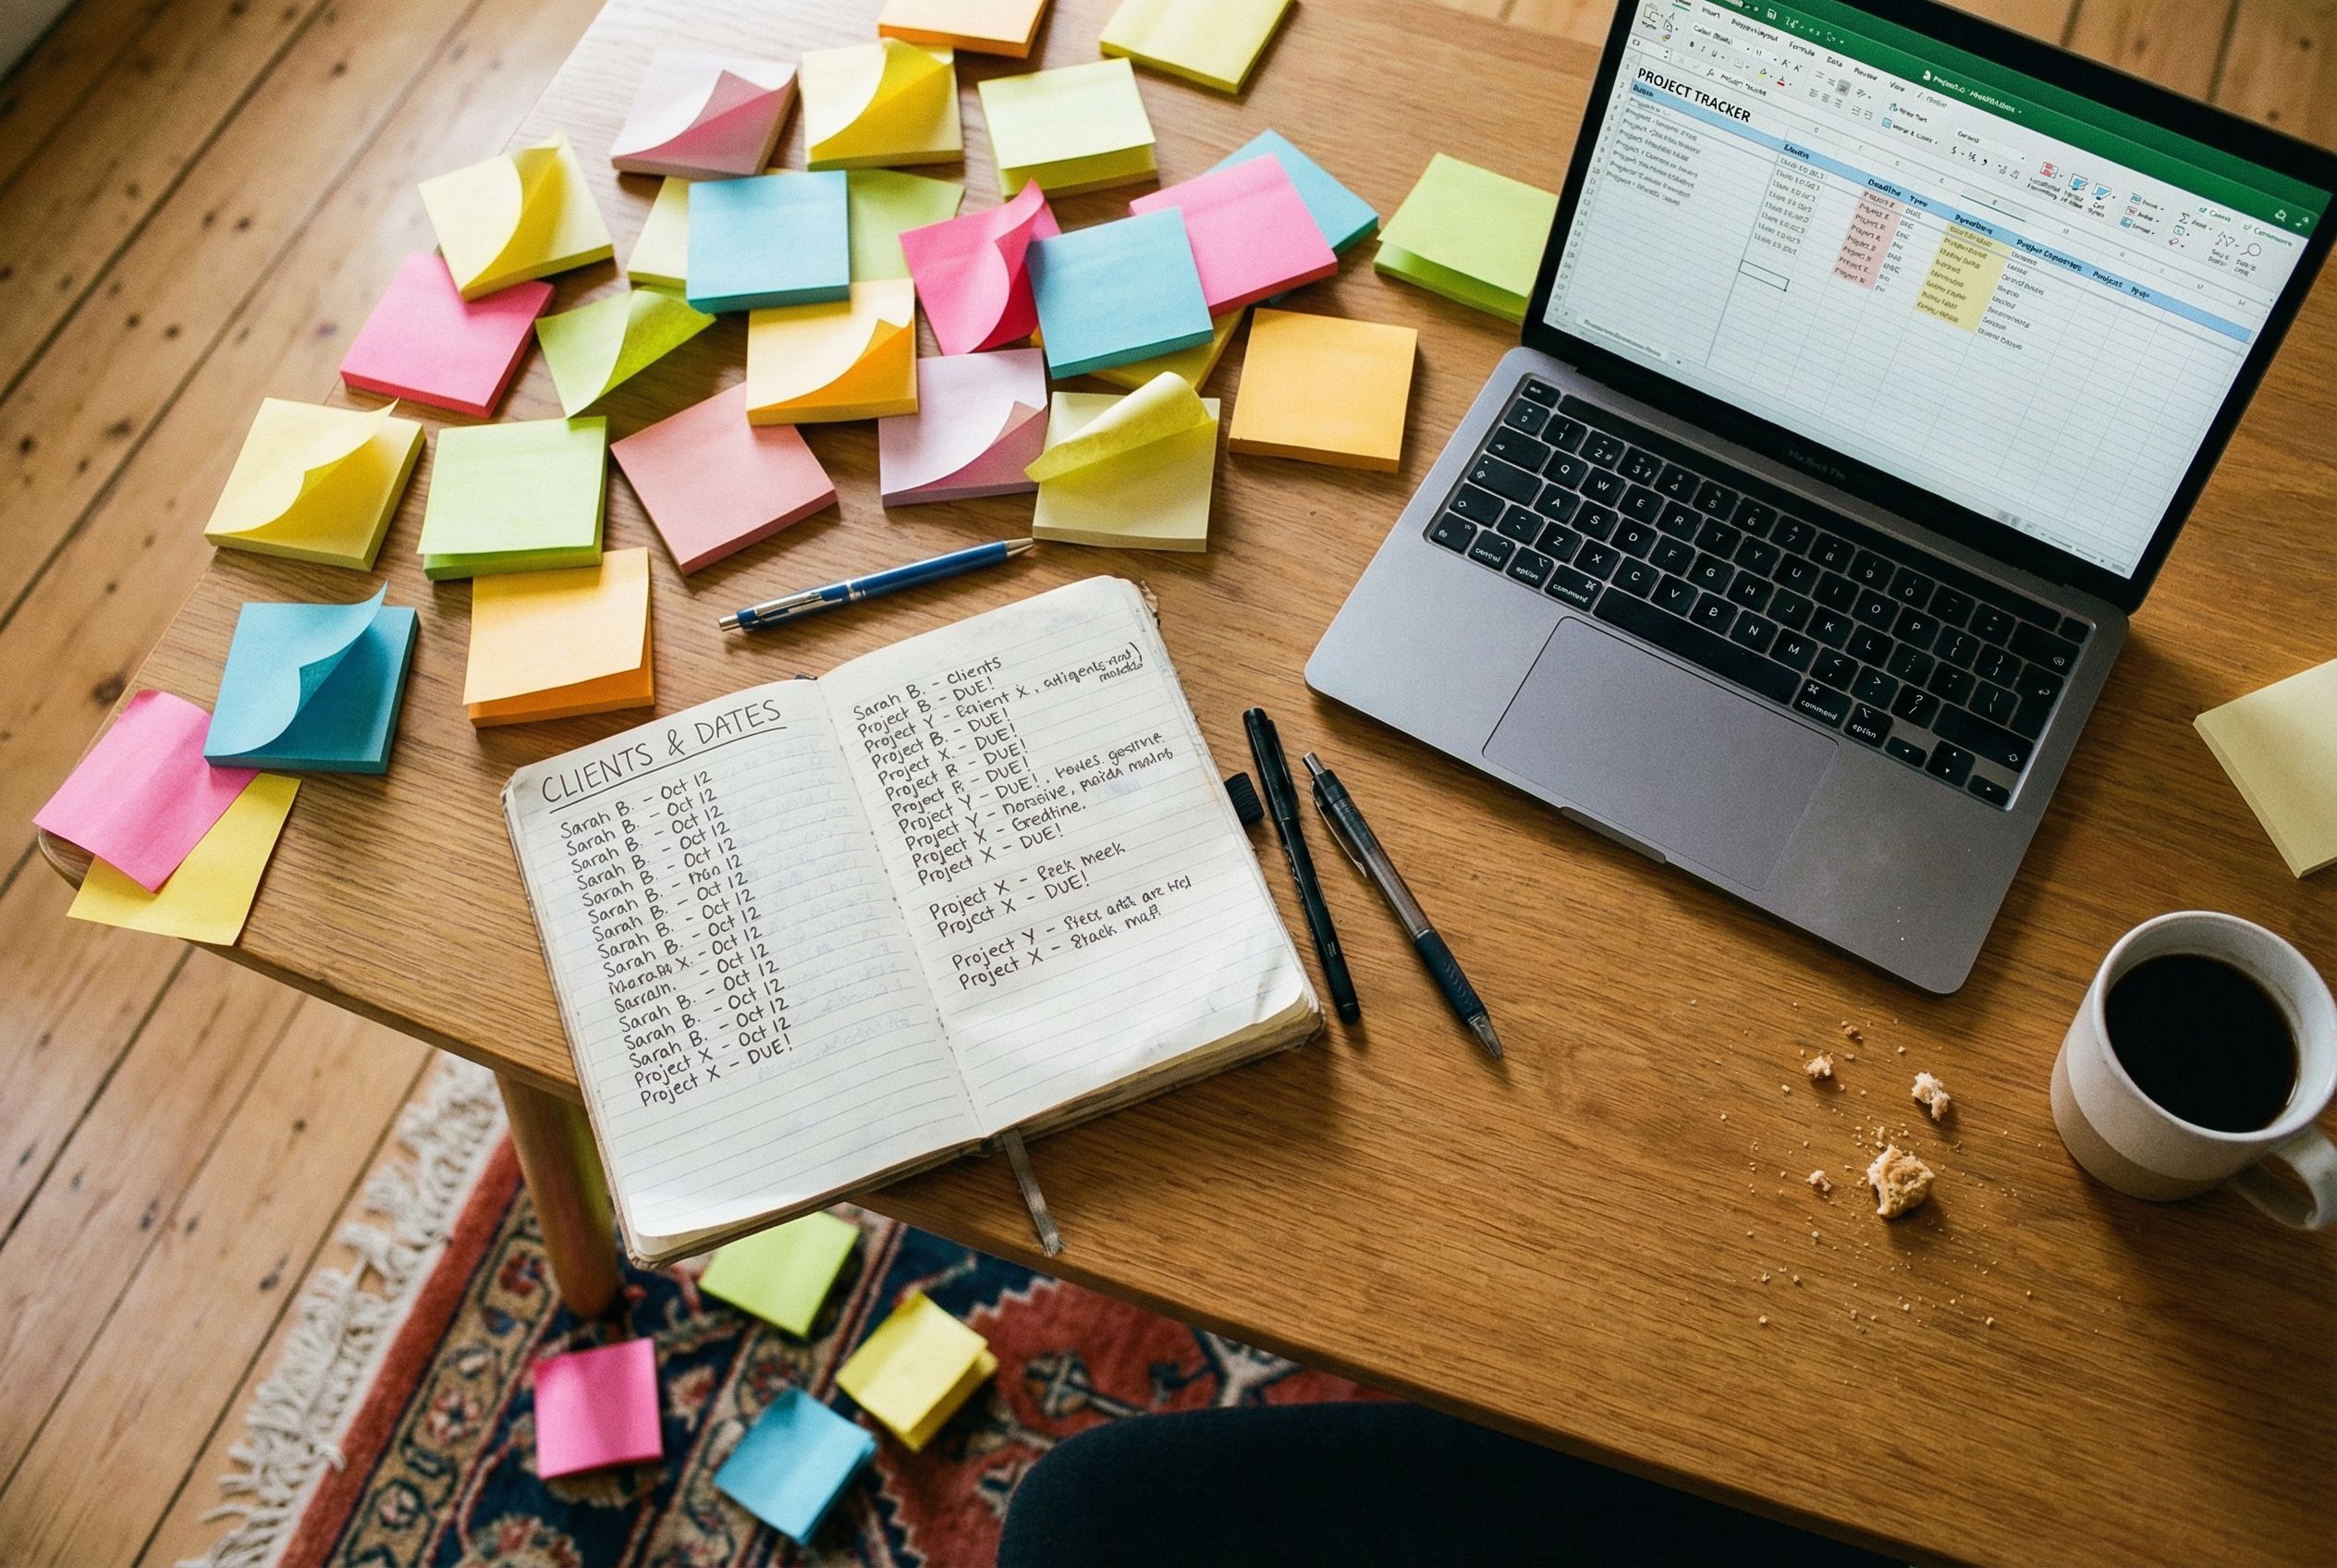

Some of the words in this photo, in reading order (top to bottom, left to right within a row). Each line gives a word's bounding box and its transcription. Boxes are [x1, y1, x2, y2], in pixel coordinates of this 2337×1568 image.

[1637, 67, 1693, 99] PROJECT
[1695, 91, 1751, 123] TRACKER
[1558, 432, 1564, 440] 1
[1594, 448, 1603, 458] 2
[1560, 464, 1570, 474] Q
[1632, 465, 1641, 474] 3
[1597, 480, 1609, 491] W
[1551, 498, 1560, 508] A
[1636, 498, 1646, 508] E
[1708, 500, 1718, 508] 5
[1590, 515, 1601, 524] S
[1674, 516, 1684, 526] R
[1747, 517, 1756, 526] 6
[1553, 536, 1564, 546] Z
[1628, 532, 1638, 542] D
[1715, 533, 1724, 542] T
[1787, 534, 1796, 543] 7
[1591, 554, 1602, 564] X
[1668, 550, 1677, 558] F
[1754, 550, 1762, 559] Y
[1631, 571, 1641, 581] C
[1706, 569, 1716, 577] G
[1792, 568, 1802, 578] U
[1866, 570, 1874, 579] 9
[1670, 588, 1681, 598] V
[1744, 585, 1756, 595] H
[1708, 607, 1719, 617] B
[1786, 605, 1795, 613] J
[1748, 625, 1759, 636] N
[1825, 621, 1835, 632] K
[1911, 622, 1921, 631] P
[1788, 643, 1800, 655] M
[1866, 640, 1872, 650] L
[853, 693, 901, 721] Sarah
[947, 656, 1002, 684] Clients
[857, 706, 910, 739] Project
[952, 675, 995, 702] DUE!
[863, 721, 916, 754] Project
[922, 714, 935, 729] Y
[871, 738, 924, 770] Project
[967, 706, 1010, 733] DUE!
[542, 742, 654, 803] CLIENTS
[667, 729, 686, 756] &
[693, 699, 781, 745] DATES
[877, 754, 930, 787] Project
[973, 722, 1018, 752] DUE!
[885, 770, 938, 802] Project
[983, 738, 1029, 766] DUE!
[891, 787, 945, 818] Project
[985, 755, 1031, 783] DUE!
[560, 812, 611, 839] Sarah
[660, 778, 689, 801] Oct
[693, 770, 713, 788] 12
[898, 802, 953, 835] Project
[957, 793, 973, 812] Y
[566, 828, 617, 857] Sarah
[667, 796, 693, 817] Oct
[699, 788, 717, 804] 12
[904, 819, 960, 851] Project
[964, 812, 978, 829] Y
[570, 847, 620, 874] Sarah
[671, 813, 699, 835] Oct
[704, 805, 725, 822] 12
[912, 837, 968, 869] Project
[973, 827, 987, 845] X
[917, 853, 973, 887] Project
[979, 846, 997, 864] X
[1019, 822, 1064, 850] DUE!
[576, 864, 626, 891] Sarah
[679, 827, 706, 851] Oct
[711, 821, 731, 838] 12
[581, 879, 634, 908] Sarah
[683, 846, 711, 868] Oct
[716, 837, 738, 854] 12
[587, 898, 639, 925] Sarah
[725, 853, 744, 871] 12
[928, 887, 986, 921] Project
[993, 879, 1010, 896] X
[936, 905, 996, 938] Project
[1000, 898, 1017, 914] X
[1043, 869, 1088, 900] DUE!
[592, 915, 643, 943] Sarah
[696, 880, 722, 901] Oct
[728, 871, 749, 889] 12
[597, 932, 650, 960] Sarah
[702, 897, 730, 920] Oct
[734, 888, 756, 906] 12
[603, 949, 657, 978] Sarah
[707, 914, 736, 937] Oct
[740, 906, 762, 924] 12
[712, 933, 738, 956] Oct
[742, 925, 763, 943] 12
[951, 937, 1015, 972] Project
[1021, 927, 1035, 946] Y
[716, 950, 744, 974] Oct
[750, 943, 770, 961] 12
[959, 955, 1020, 990] Project
[1026, 947, 1044, 966] X
[618, 1004, 671, 1033] Sarah
[723, 969, 751, 992] Oct
[757, 960, 780, 977] 12
[623, 1023, 677, 1051] Sarah
[728, 986, 757, 1011] Oct
[763, 977, 786, 996] 12
[629, 1041, 682, 1069] Sarah
[736, 1005, 765, 1028] Oct
[769, 997, 790, 1014] 12
[634, 1054, 691, 1089] Project
[697, 1047, 714, 1064] X
[738, 1024, 767, 1047] Oct
[772, 1016, 791, 1034] 12
[640, 1072, 699, 1108] Project
[705, 1064, 721, 1083] X
[746, 1033, 790, 1065] DUE!
